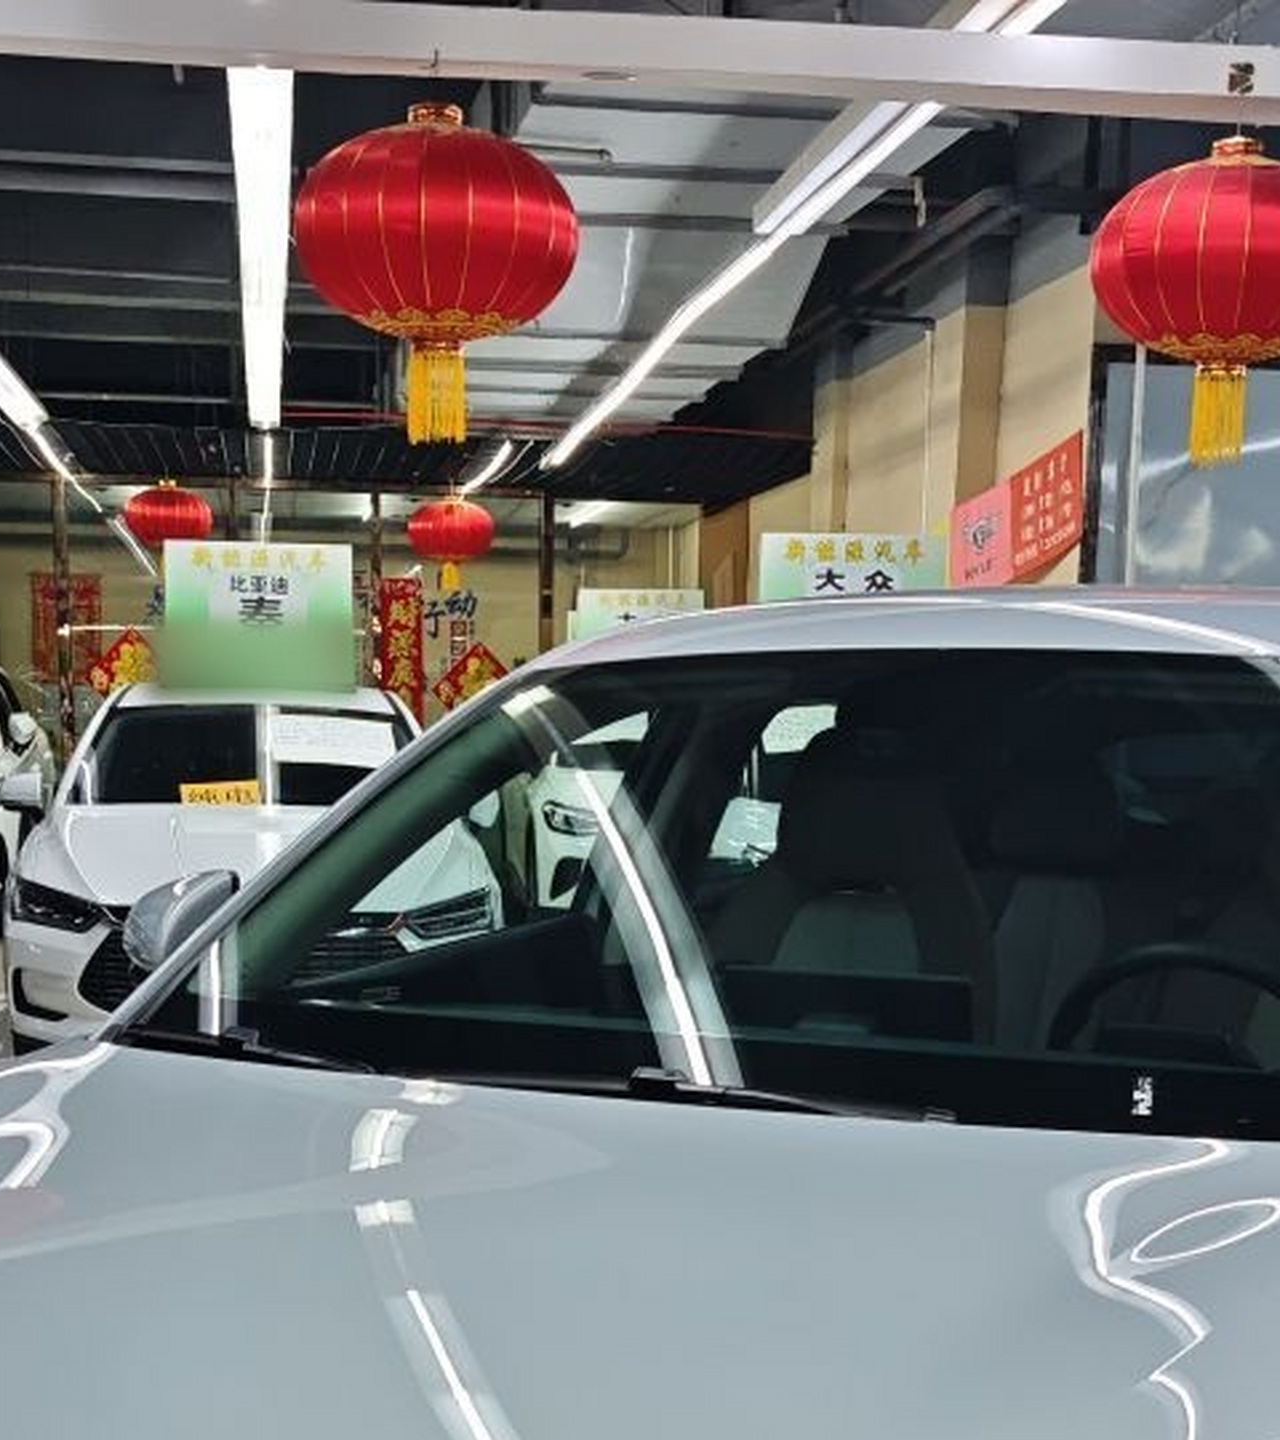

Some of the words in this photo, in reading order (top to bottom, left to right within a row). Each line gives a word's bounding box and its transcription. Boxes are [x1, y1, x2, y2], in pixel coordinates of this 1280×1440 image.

[230, 575, 289, 595] 比亚迪
[815, 568, 895, 592] 大众
